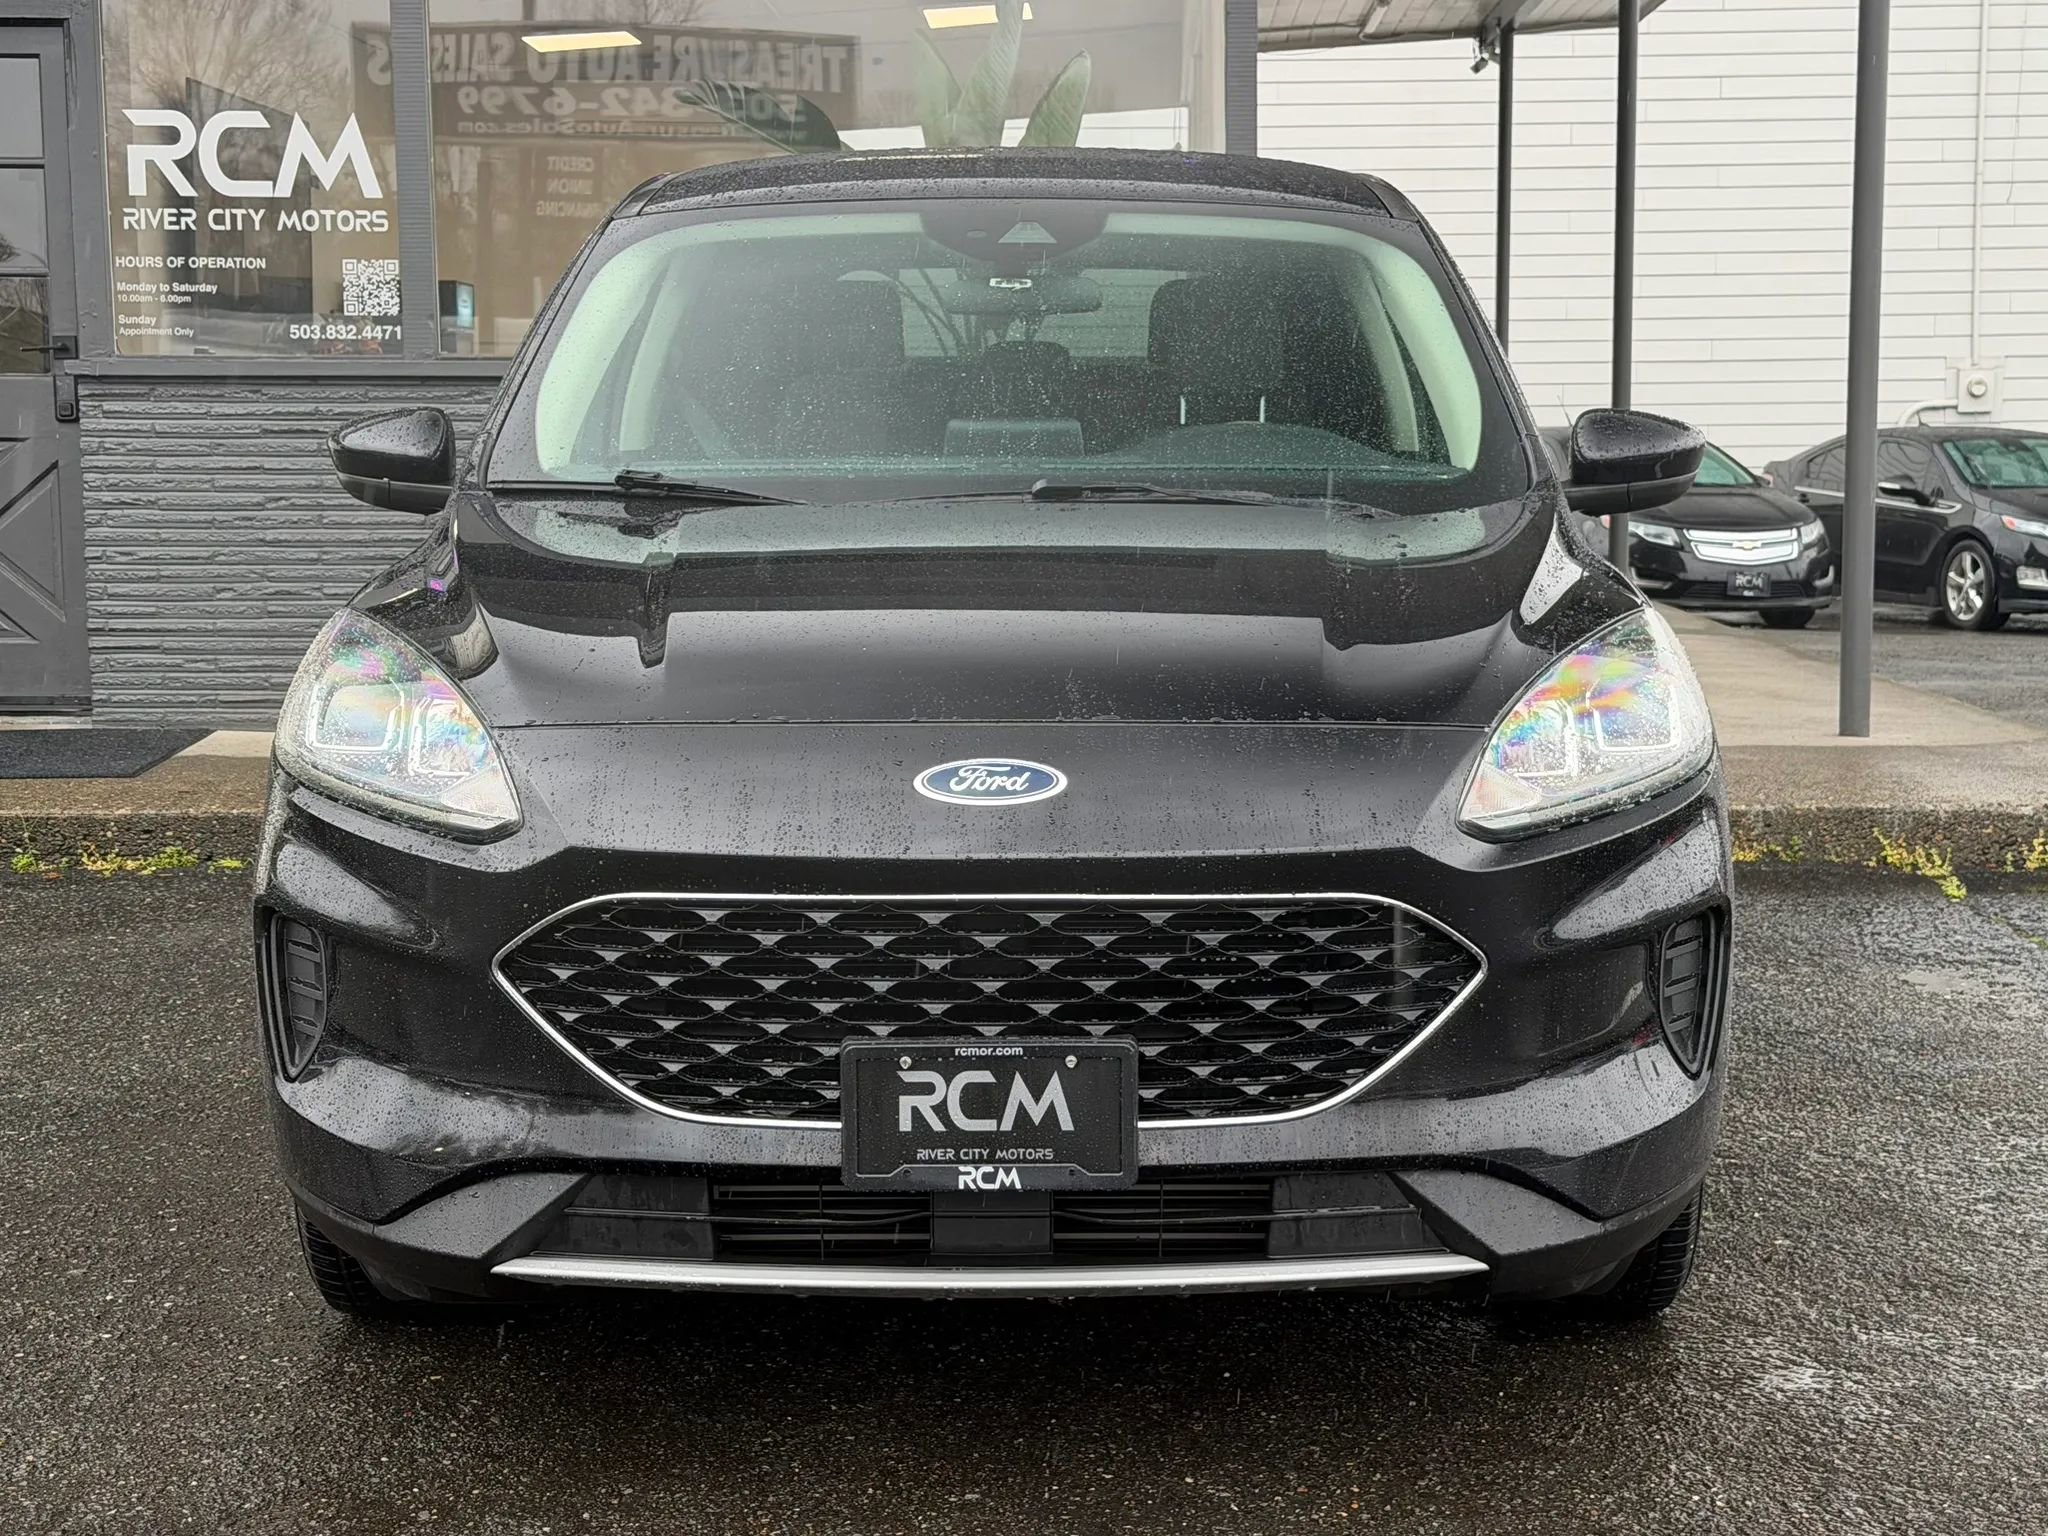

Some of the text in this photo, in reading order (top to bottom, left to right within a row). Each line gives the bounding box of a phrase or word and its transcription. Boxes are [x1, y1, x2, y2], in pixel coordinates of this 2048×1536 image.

[121, 109, 384, 198] RCM
[122, 208, 389, 232] RIVER CITY MOTORS
[115, 256, 266, 270] HOURS OF OPERATION
[117, 282, 218, 294] Monday to Saturday
[118, 314, 157, 326] Sunday
[119, 327, 194, 338] Appointment Only
[289, 324, 402, 340] 503.832.4471
[949, 765, 1031, 792] Ford
[954, 1045, 1023, 1056] rcmor.com
[896, 1070, 1075, 1131] RCM
[916, 1148, 1054, 1160] RIVER CITY MOTORS
[958, 1166, 1022, 1189] RCM
